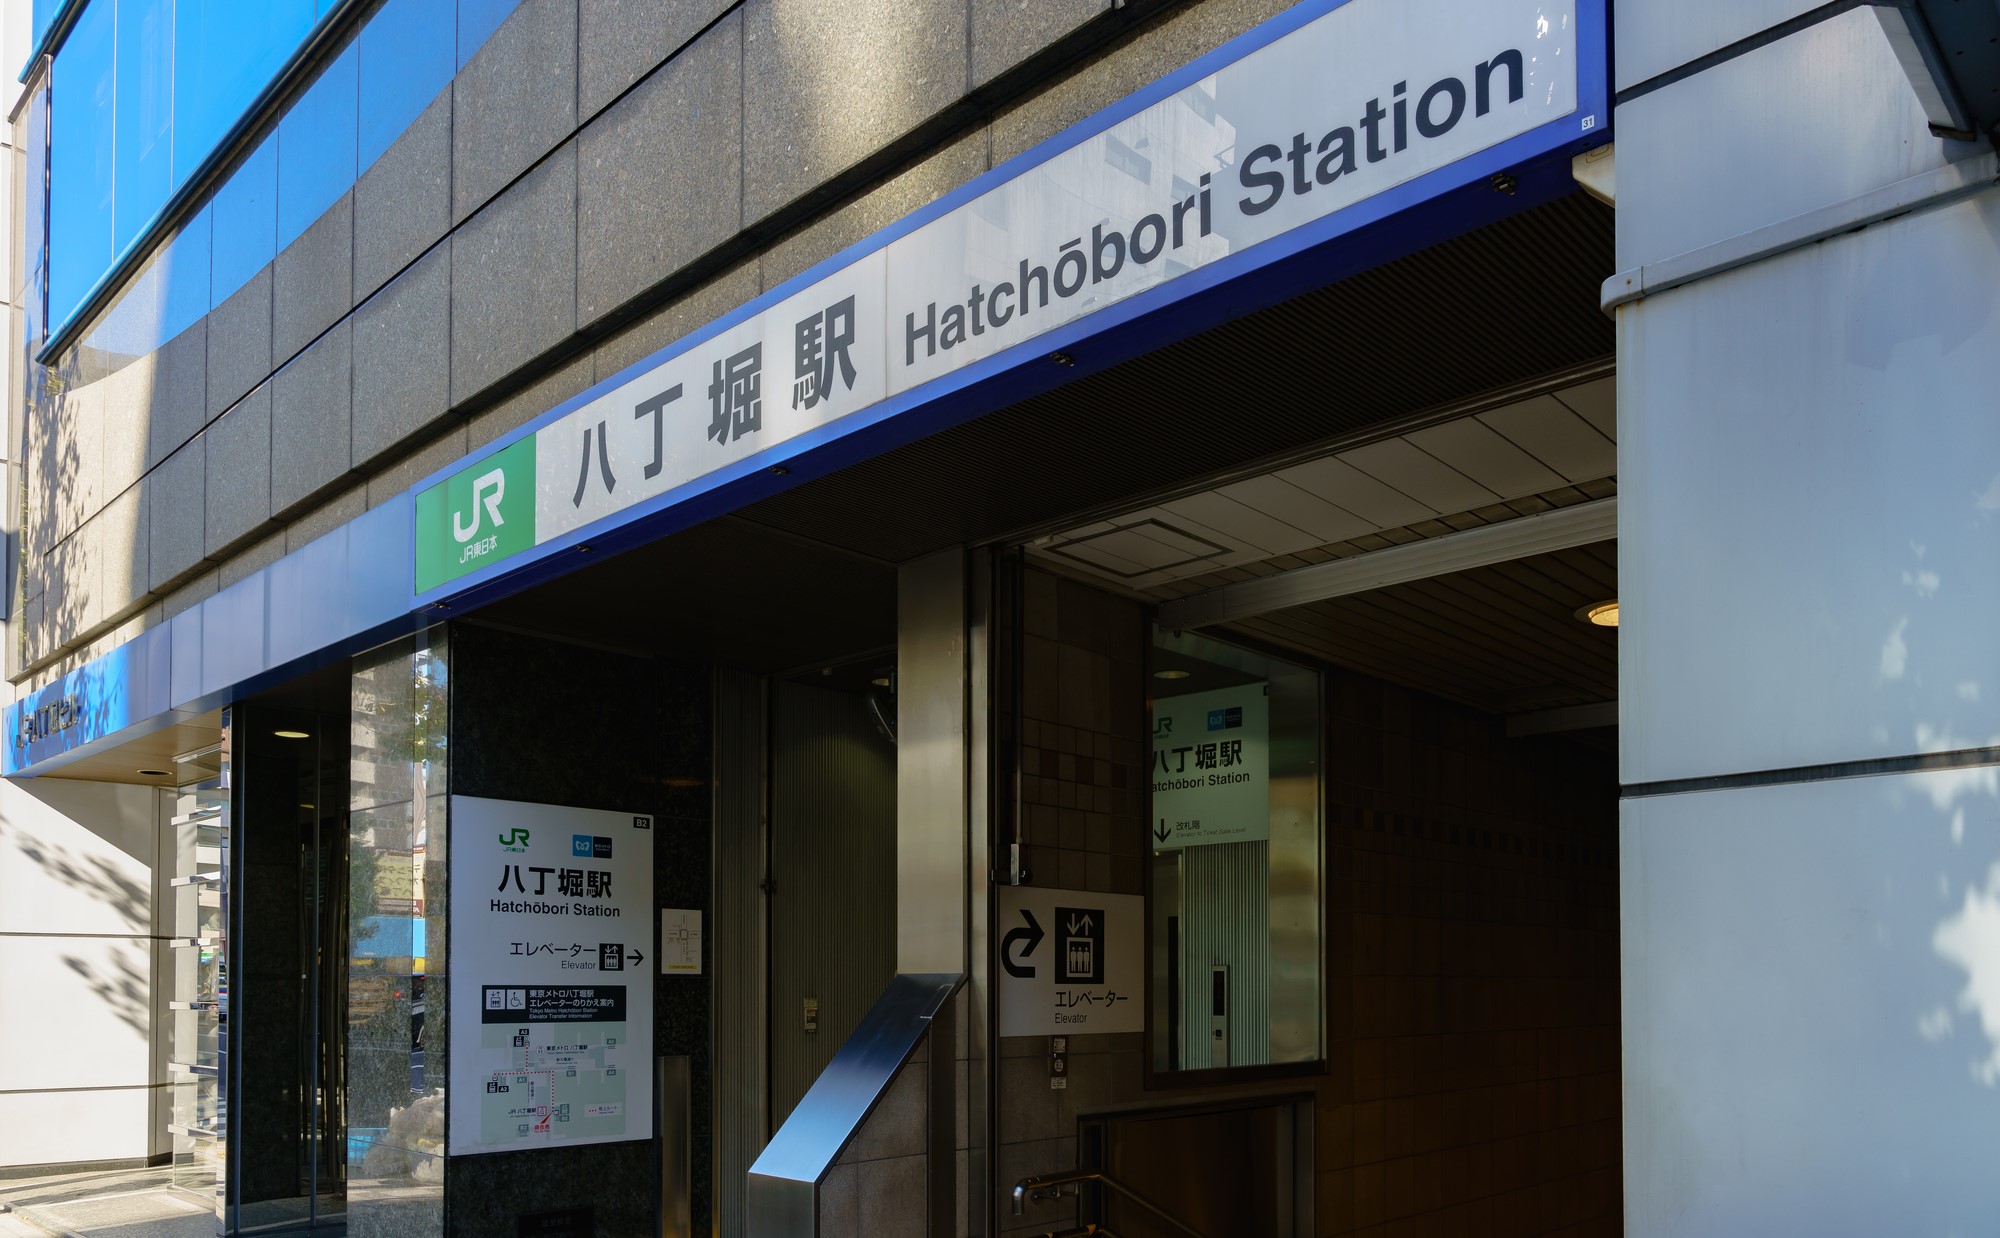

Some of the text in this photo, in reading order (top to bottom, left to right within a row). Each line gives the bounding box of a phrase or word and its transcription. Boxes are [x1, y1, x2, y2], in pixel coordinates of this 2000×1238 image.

[1583, 117, 1593, 128] 31
[906, 47, 1525, 366] Hatchōbori Station
[573, 295, 857, 509] 八丁堀駅
[453, 467, 506, 543] JR
[459, 534, 498, 564] JR東日本
[1152, 739, 1242, 774] 八丁堀駅
[1152, 772, 1250, 792] atchōbori Station
[636, 818, 647, 828] B2
[1176, 820, 1200, 831] 改札階
[499, 828, 530, 848] JR
[498, 865, 613, 899] 八丁堀駅
[490, 899, 621, 917] Hatchōbori Station
[510, 942, 597, 957] エレベーター
[561, 960, 597, 970] Elevator
[529, 989, 595, 998] 東京メトロ八丁堀駅
[1055, 990, 1128, 1008] エレベーター
[529, 998, 614, 1008] エレベーターのりかえ案内
[1055, 1013, 1088, 1024] Elevator
